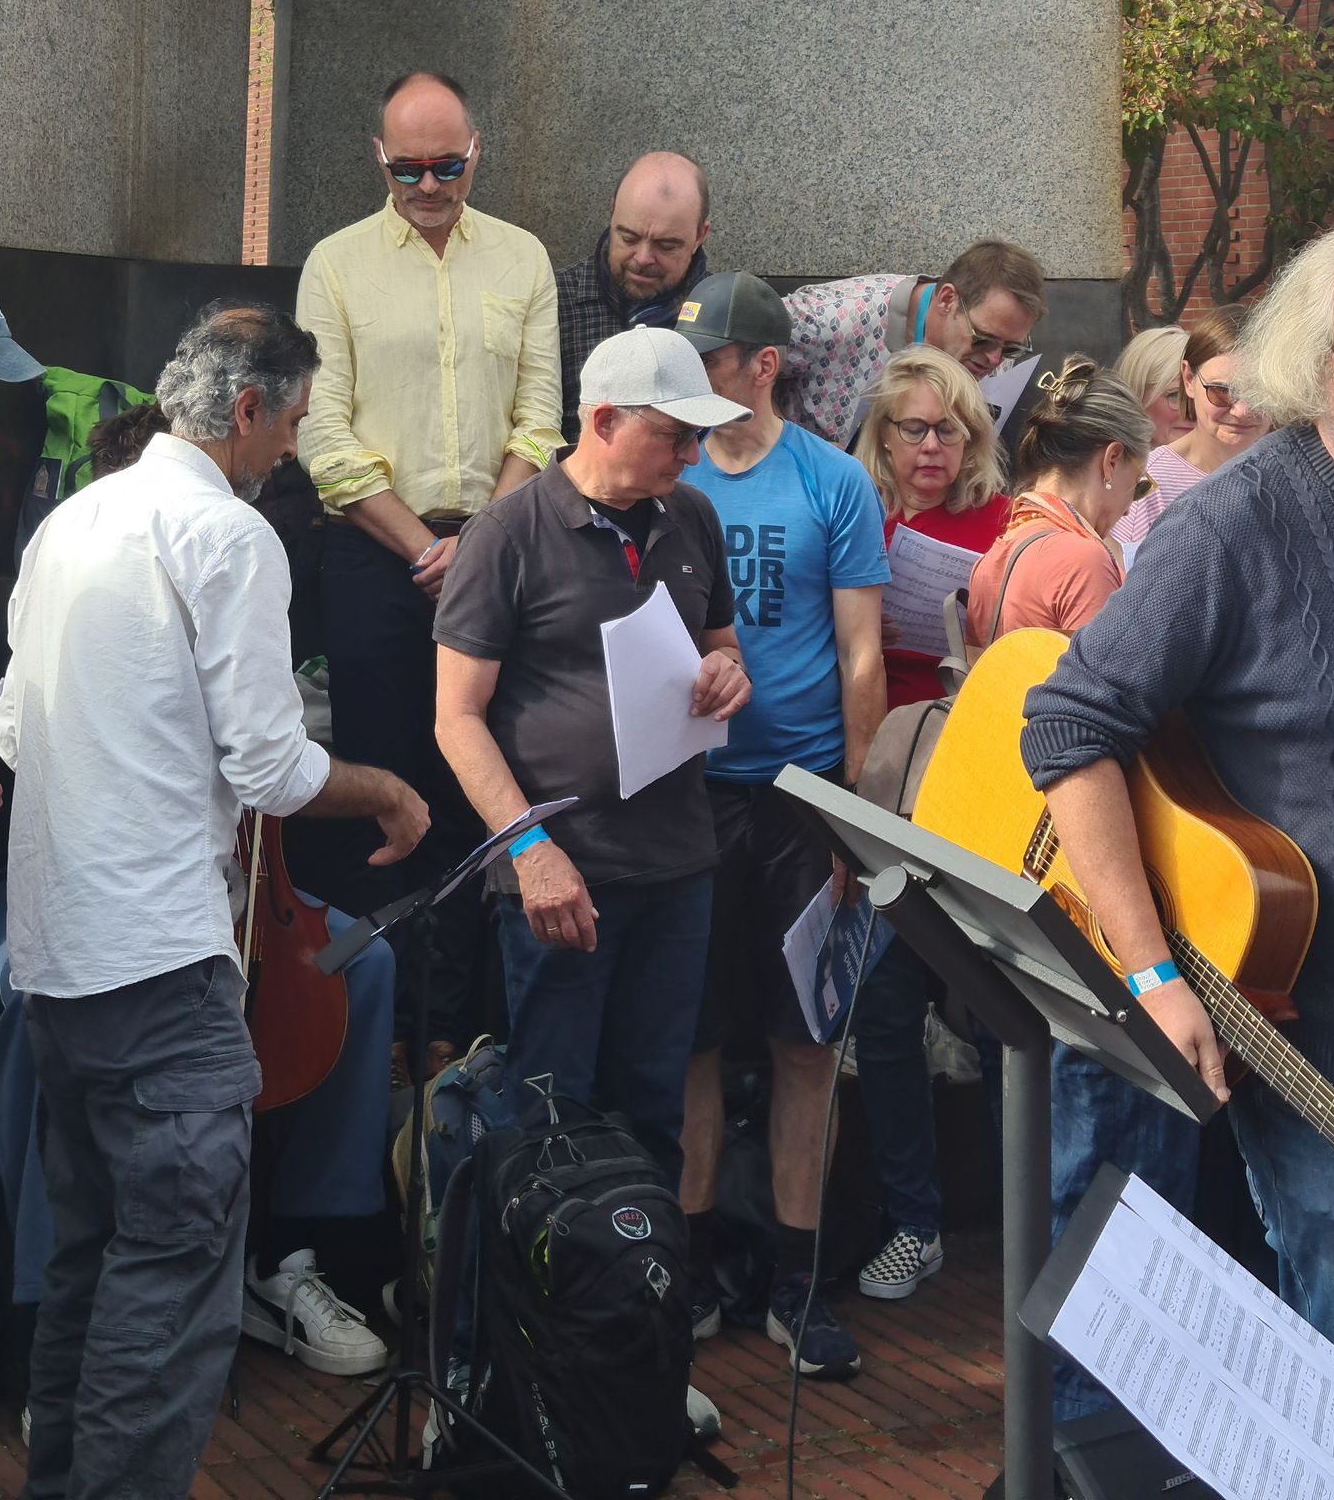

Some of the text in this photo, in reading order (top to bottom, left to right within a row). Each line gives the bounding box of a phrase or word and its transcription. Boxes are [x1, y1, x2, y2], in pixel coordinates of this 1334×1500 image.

[726, 525, 785, 558] DE
[731, 559, 784, 589] UR
[733, 588, 784, 627] KE
[545, 1440, 557, 1460] 26
